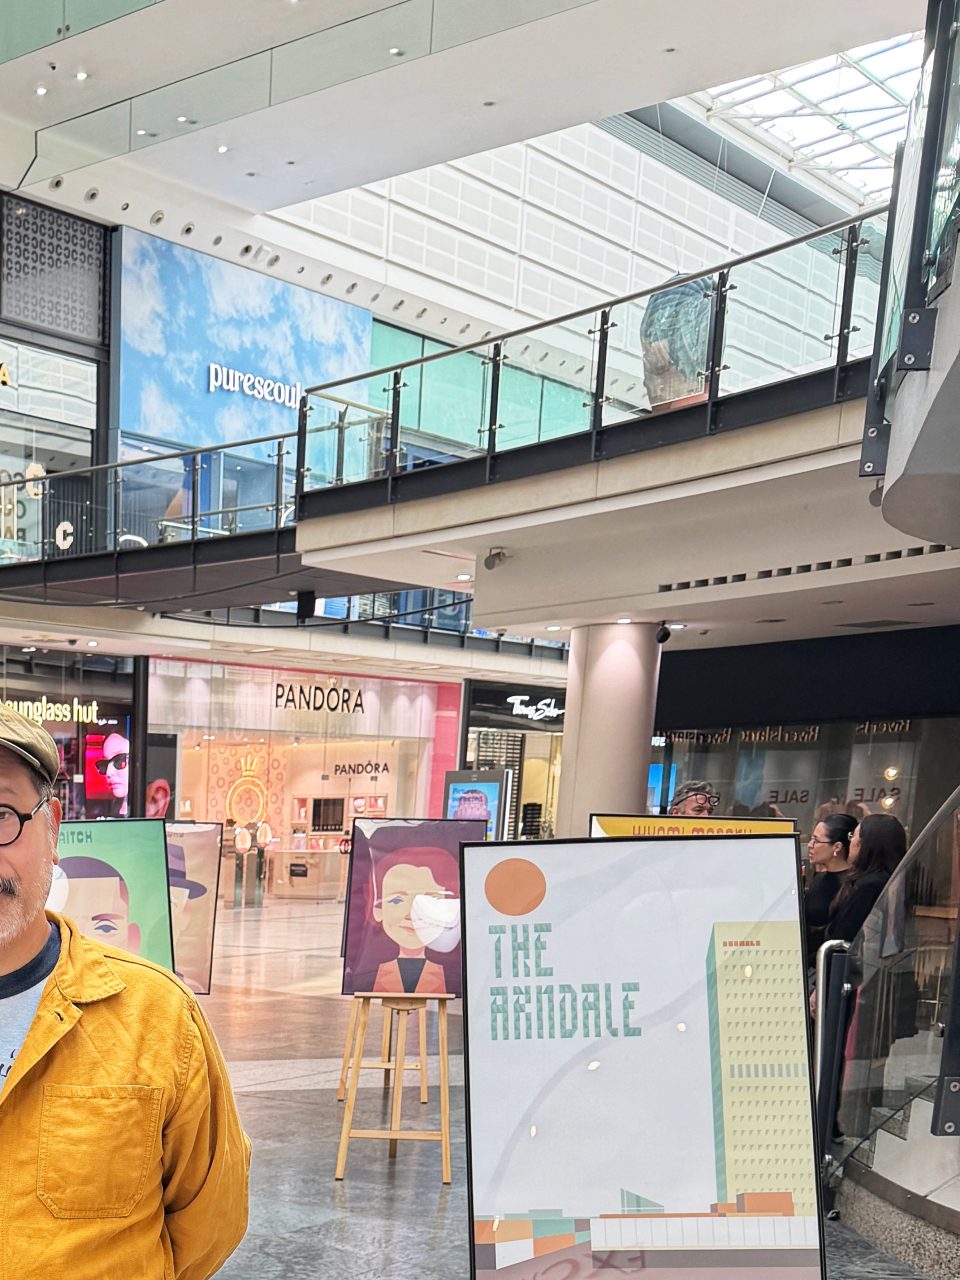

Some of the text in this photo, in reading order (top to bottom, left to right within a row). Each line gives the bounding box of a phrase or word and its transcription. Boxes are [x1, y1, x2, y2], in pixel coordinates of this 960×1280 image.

[209, 363, 302, 410] pureseoul
[73, 697, 98, 724] hut
[275, 682, 364, 714] PANDORA
[334, 762, 390, 775] PANDORA
[488, 923, 553, 978] THE
[490, 982, 642, 1040] ARNDALE
